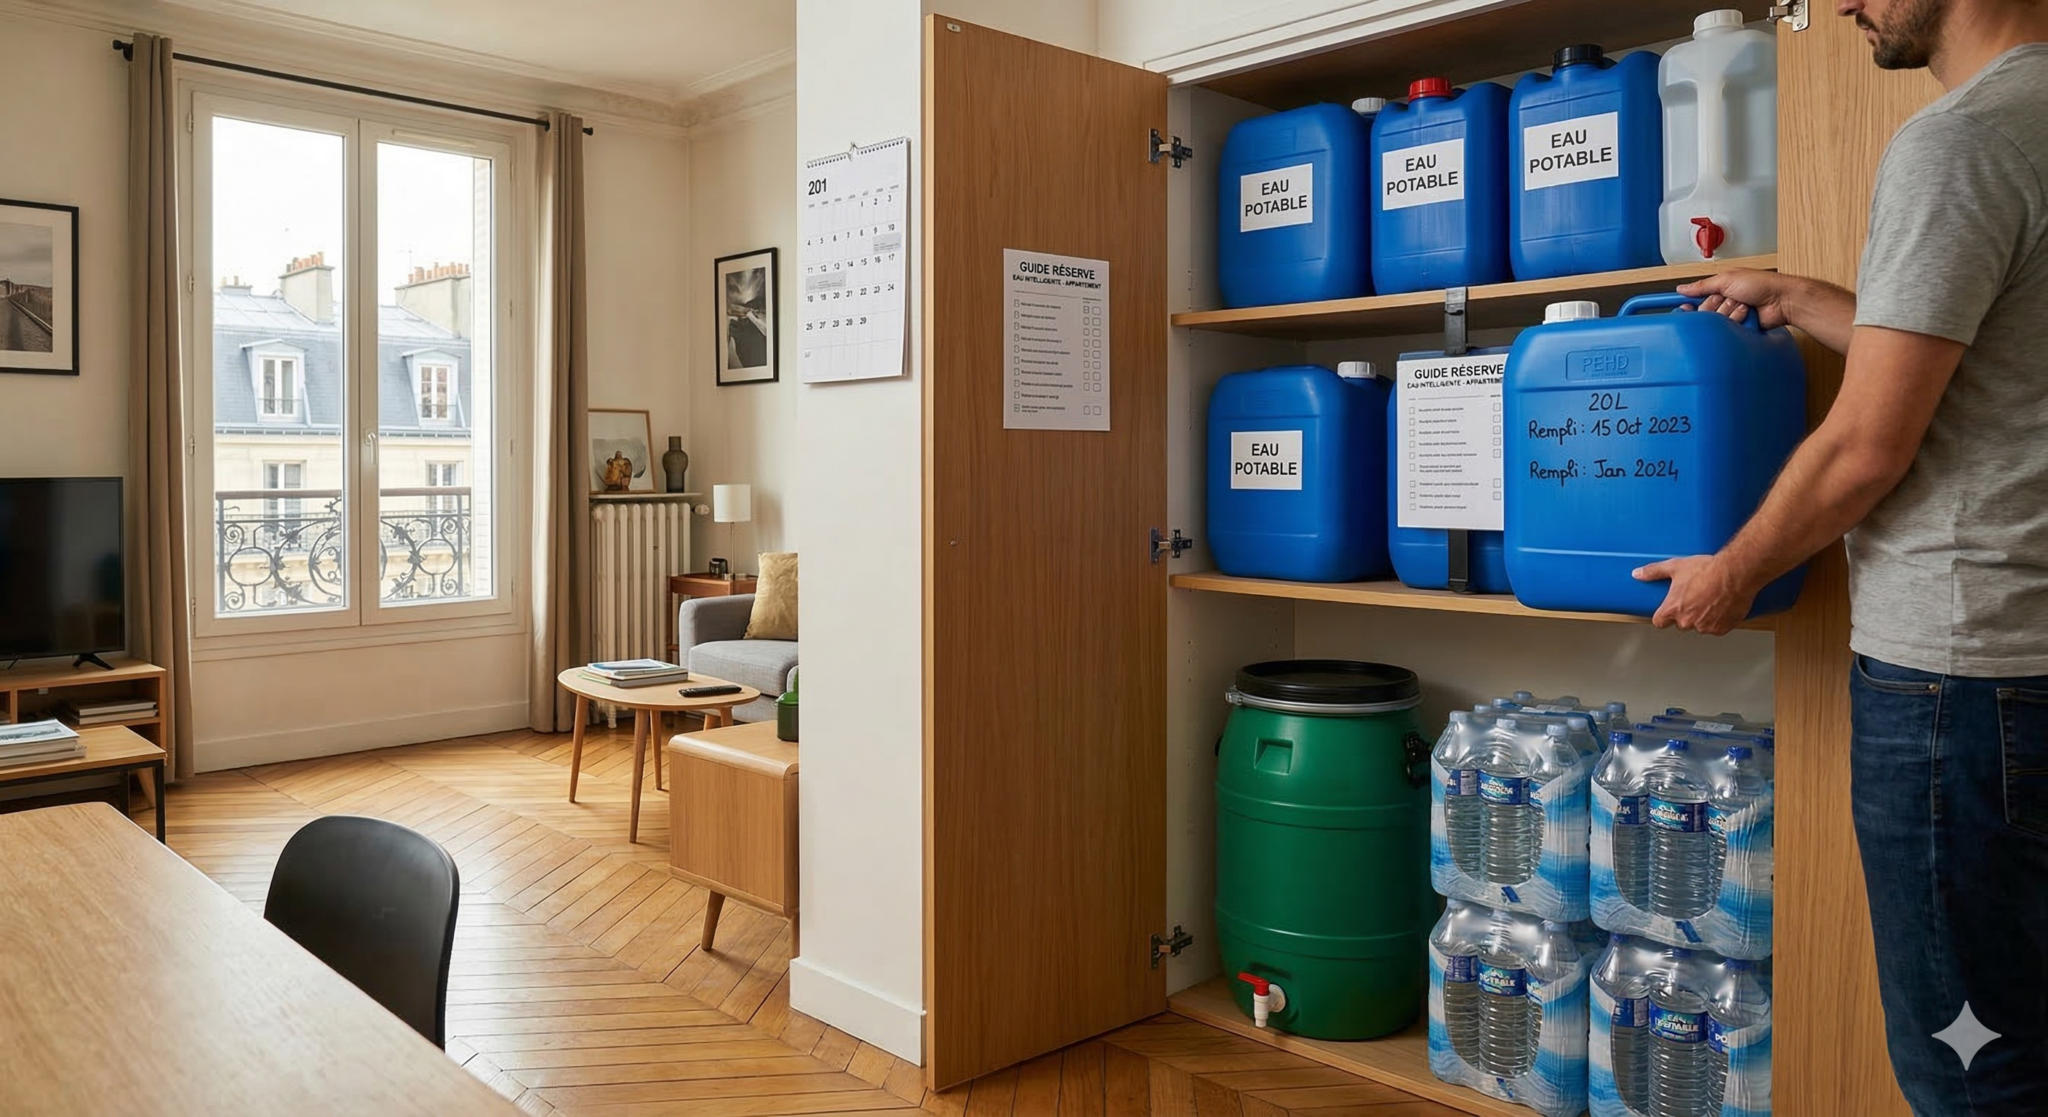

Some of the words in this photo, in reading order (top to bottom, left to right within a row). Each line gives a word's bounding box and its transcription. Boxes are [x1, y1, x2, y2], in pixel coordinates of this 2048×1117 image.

[1552, 129, 1587, 149] EAU
[1406, 154, 1436, 172] EAU
[1530, 147, 1612, 173] POTABLE
[808, 177, 827, 196] 201
[1261, 179, 1289, 196] EAU
[1387, 171, 1458, 195] POTABLE
[1245, 195, 1307, 217] POTABLE
[1020, 262, 1050, 274] GUIDE
[1052, 264, 1095, 280] RÉSERVE
[1414, 367, 1448, 379] GUIDE
[1451, 364, 1503, 377] RÉSERVE
[1583, 355, 1629, 372] PEHD
[1588, 392, 1628, 411] 20L
[1590, 419, 1611, 436] 15
[1616, 416, 1643, 435] Oct
[1648, 416, 1692, 435] 2023
[1252, 443, 1279, 456] EAU
[1235, 462, 1297, 476] POTABLE
[1594, 458, 1626, 478] Jan
[1634, 458, 1680, 482] 2024
